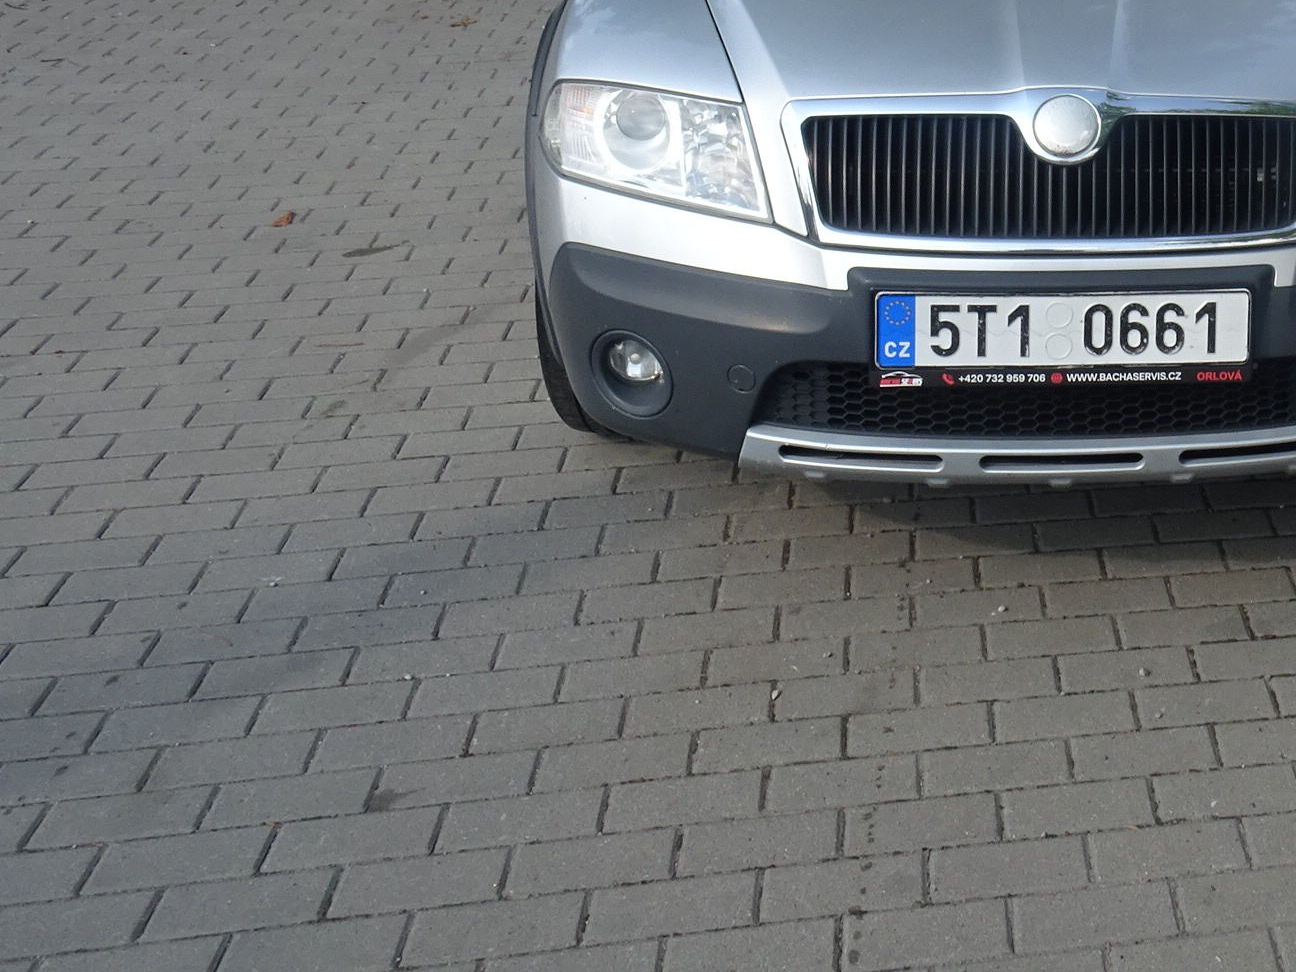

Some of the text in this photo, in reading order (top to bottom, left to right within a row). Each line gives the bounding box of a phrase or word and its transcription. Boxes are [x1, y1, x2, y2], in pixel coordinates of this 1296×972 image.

[929, 301, 1218, 358] 5T1 0661
[884, 341, 911, 358] CZ
[958, 370, 1243, 383] +420 732 959 706 WWW.BACHASERVIS.CZ ORLOVÁ
